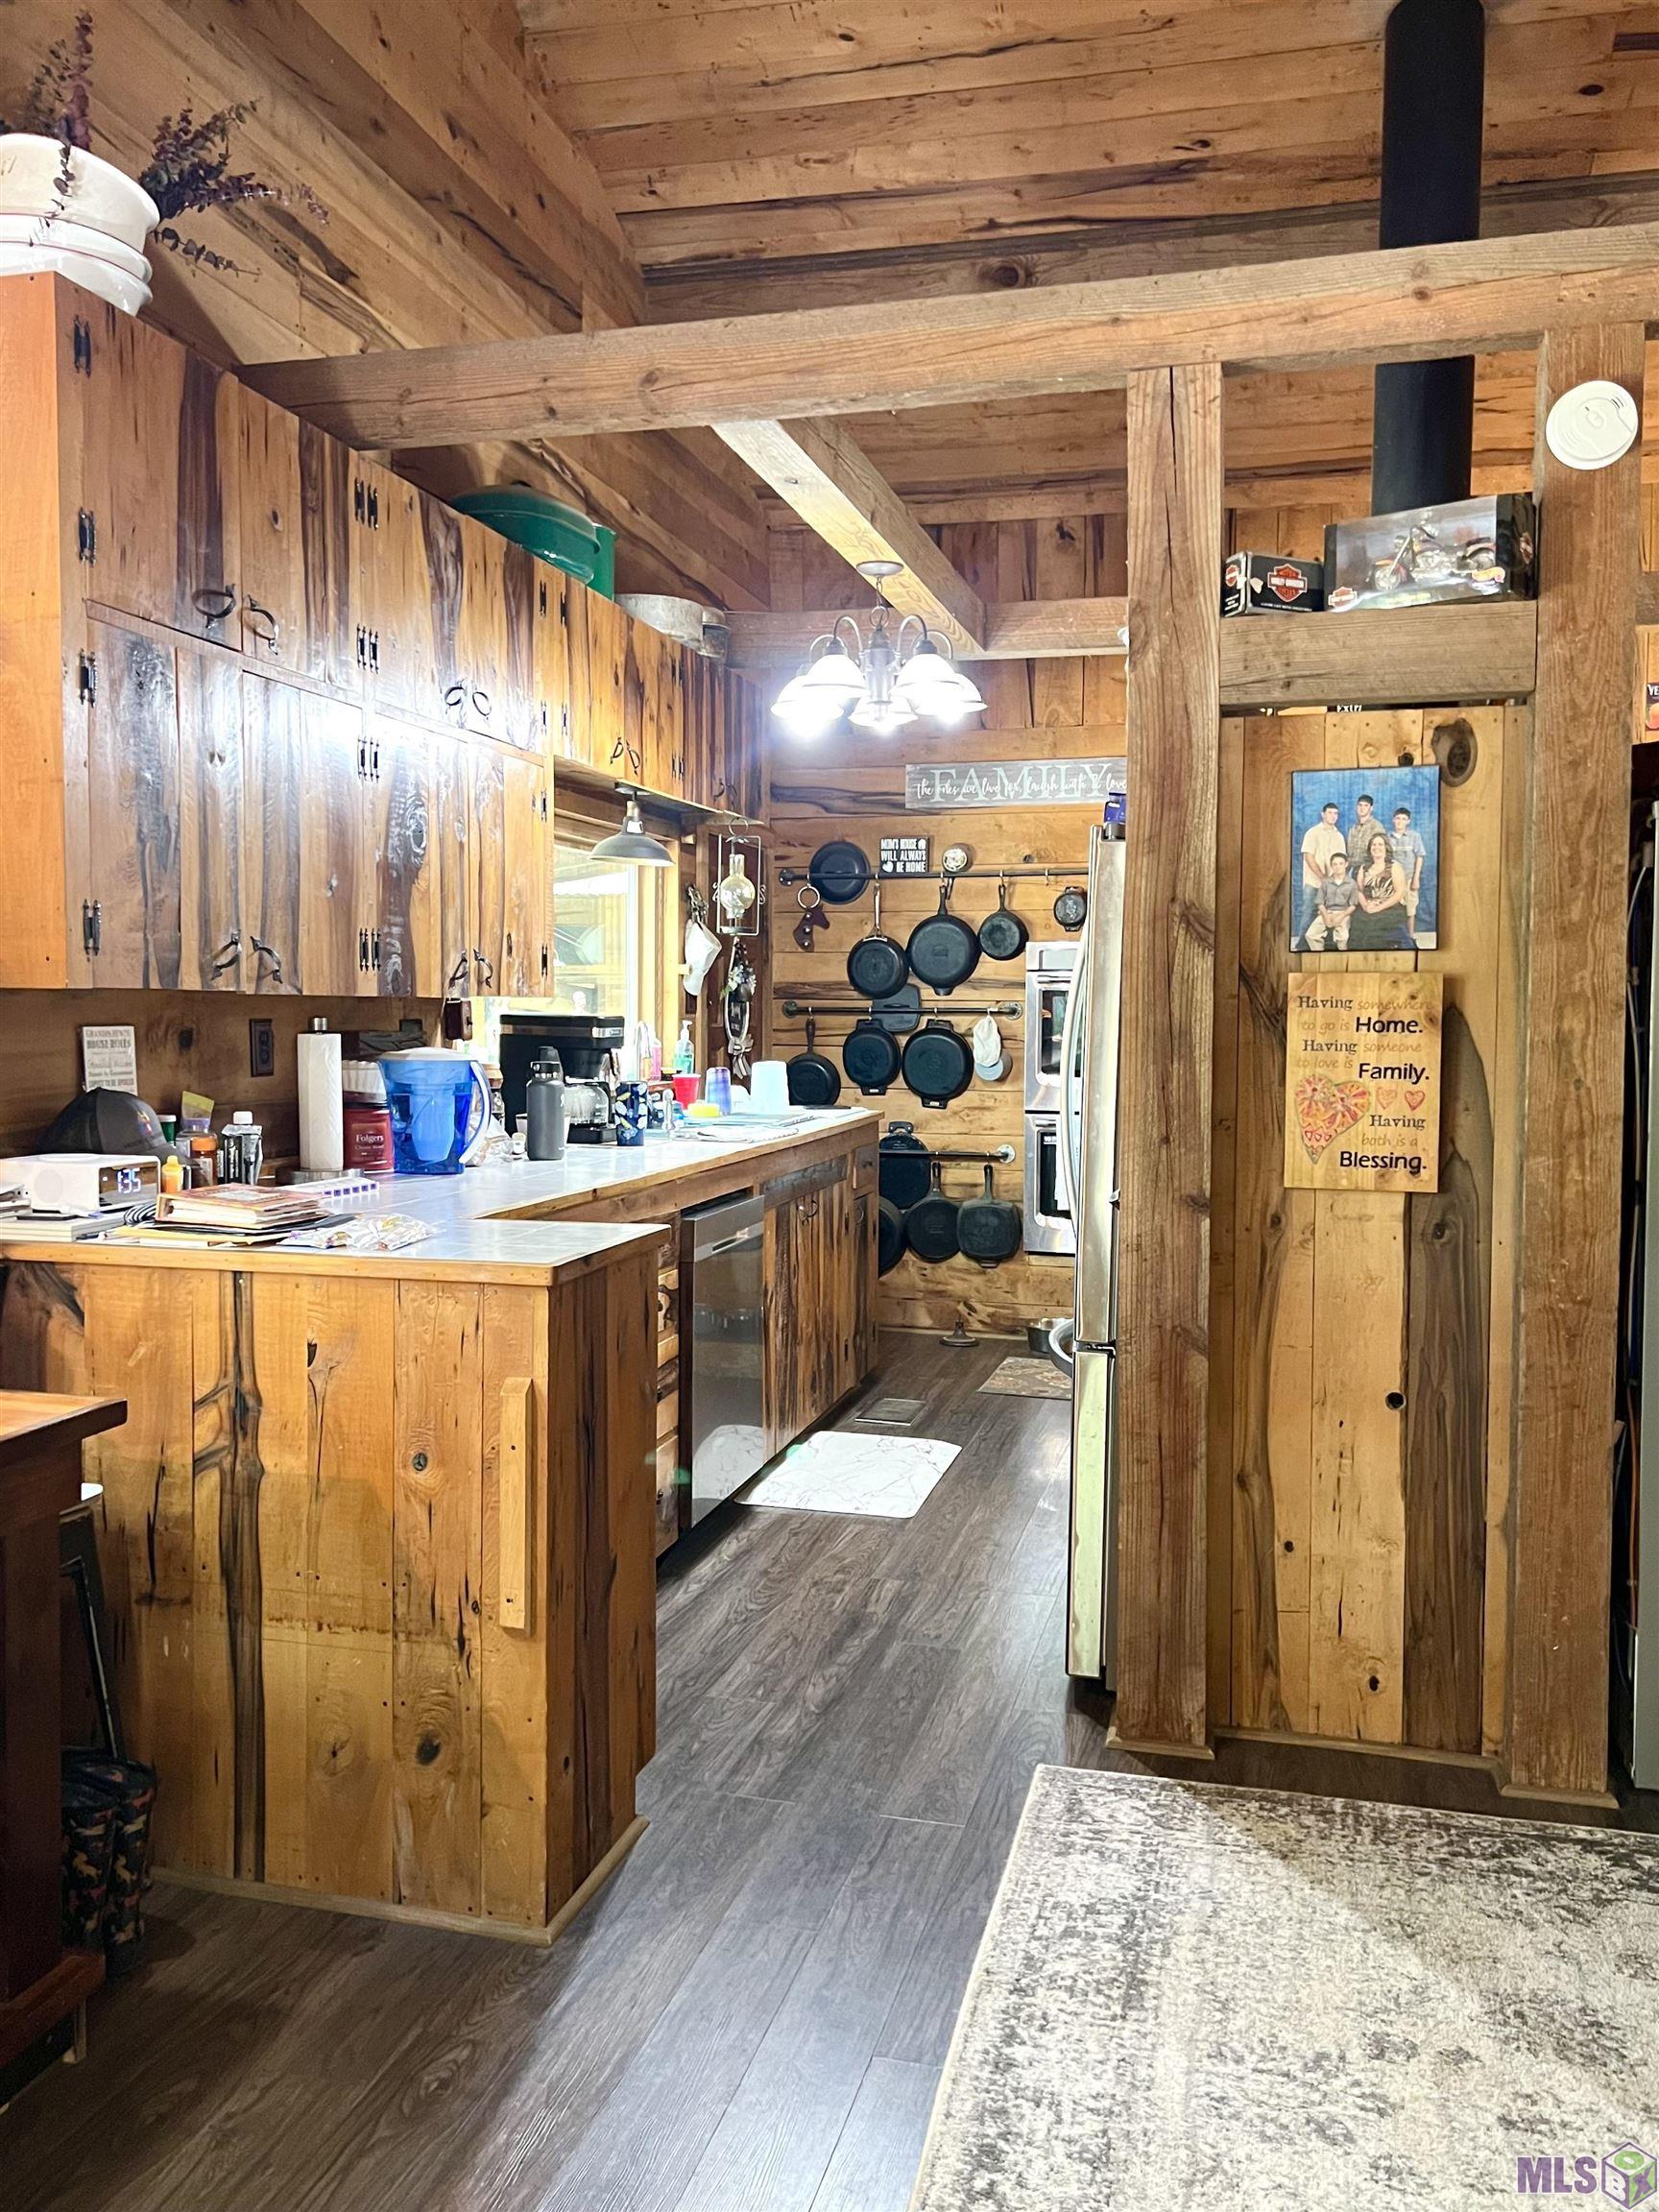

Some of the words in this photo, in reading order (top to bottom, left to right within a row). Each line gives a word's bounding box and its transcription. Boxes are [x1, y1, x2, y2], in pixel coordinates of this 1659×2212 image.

[912, 778, 934, 799] the
[1028, 774, 1059, 797] laugh
[1106, 773, 1127, 791] love
[929, 763, 1113, 803] FAMILY
[880, 850, 898, 861] WILL
[900, 850, 926, 861] ALWAYS
[896, 861, 904, 873] BE
[905, 861, 926, 873] HOME
[1297, 996, 1353, 1009] Having
[1358, 998, 1432, 1011] somewhere
[1302, 1020, 1315, 1031] to
[1318, 1022, 1335, 1035] go
[1339, 1019, 1350, 1031] is
[1356, 1017, 1423, 1033] Home.
[1302, 1039, 1358, 1054] Having
[1363, 1043, 1422, 1053] someone
[1297, 1057, 1311, 1069] to
[1315, 1057, 1339, 1069] love
[1343, 1057, 1354, 1069] is
[1358, 1063, 1430, 1084] Family.
[1369, 1115, 1426, 1129] Having
[356, 1130, 384, 1143] Folgers
[1361, 1134, 1391, 1146] both
[1396, 1134, 1406, 1146] is
[1409, 1137, 1418, 1146] a
[1340, 1151, 1427, 1176] Blessing.
